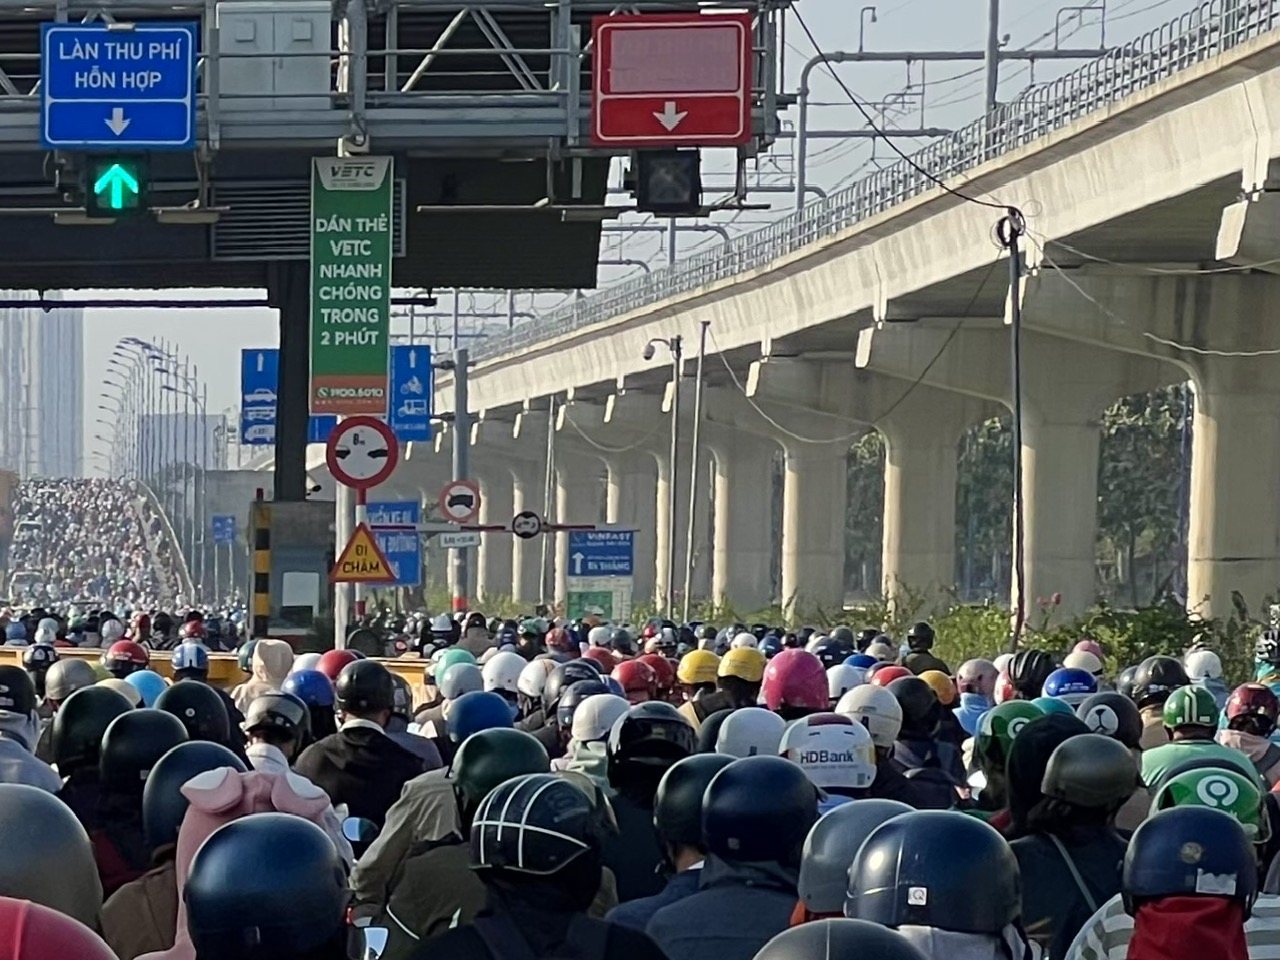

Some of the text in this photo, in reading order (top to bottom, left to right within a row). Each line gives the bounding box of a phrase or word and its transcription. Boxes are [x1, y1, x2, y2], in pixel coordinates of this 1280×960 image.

[60, 37, 182, 60] LÀN THU PHÍ
[75, 65, 162, 92] HỖN HỢP
[330, 164, 375, 178] VETC
[316, 213, 388, 232] DÁN THẺ
[330, 240, 372, 256] VETC
[320, 264, 382, 278] NHANH
[319, 282, 382, 300] CHÓNG
[320, 308, 379, 323] TRONG
[320, 327, 379, 346] 2 PHÚT
[800, 750, 854, 763] HDBank
